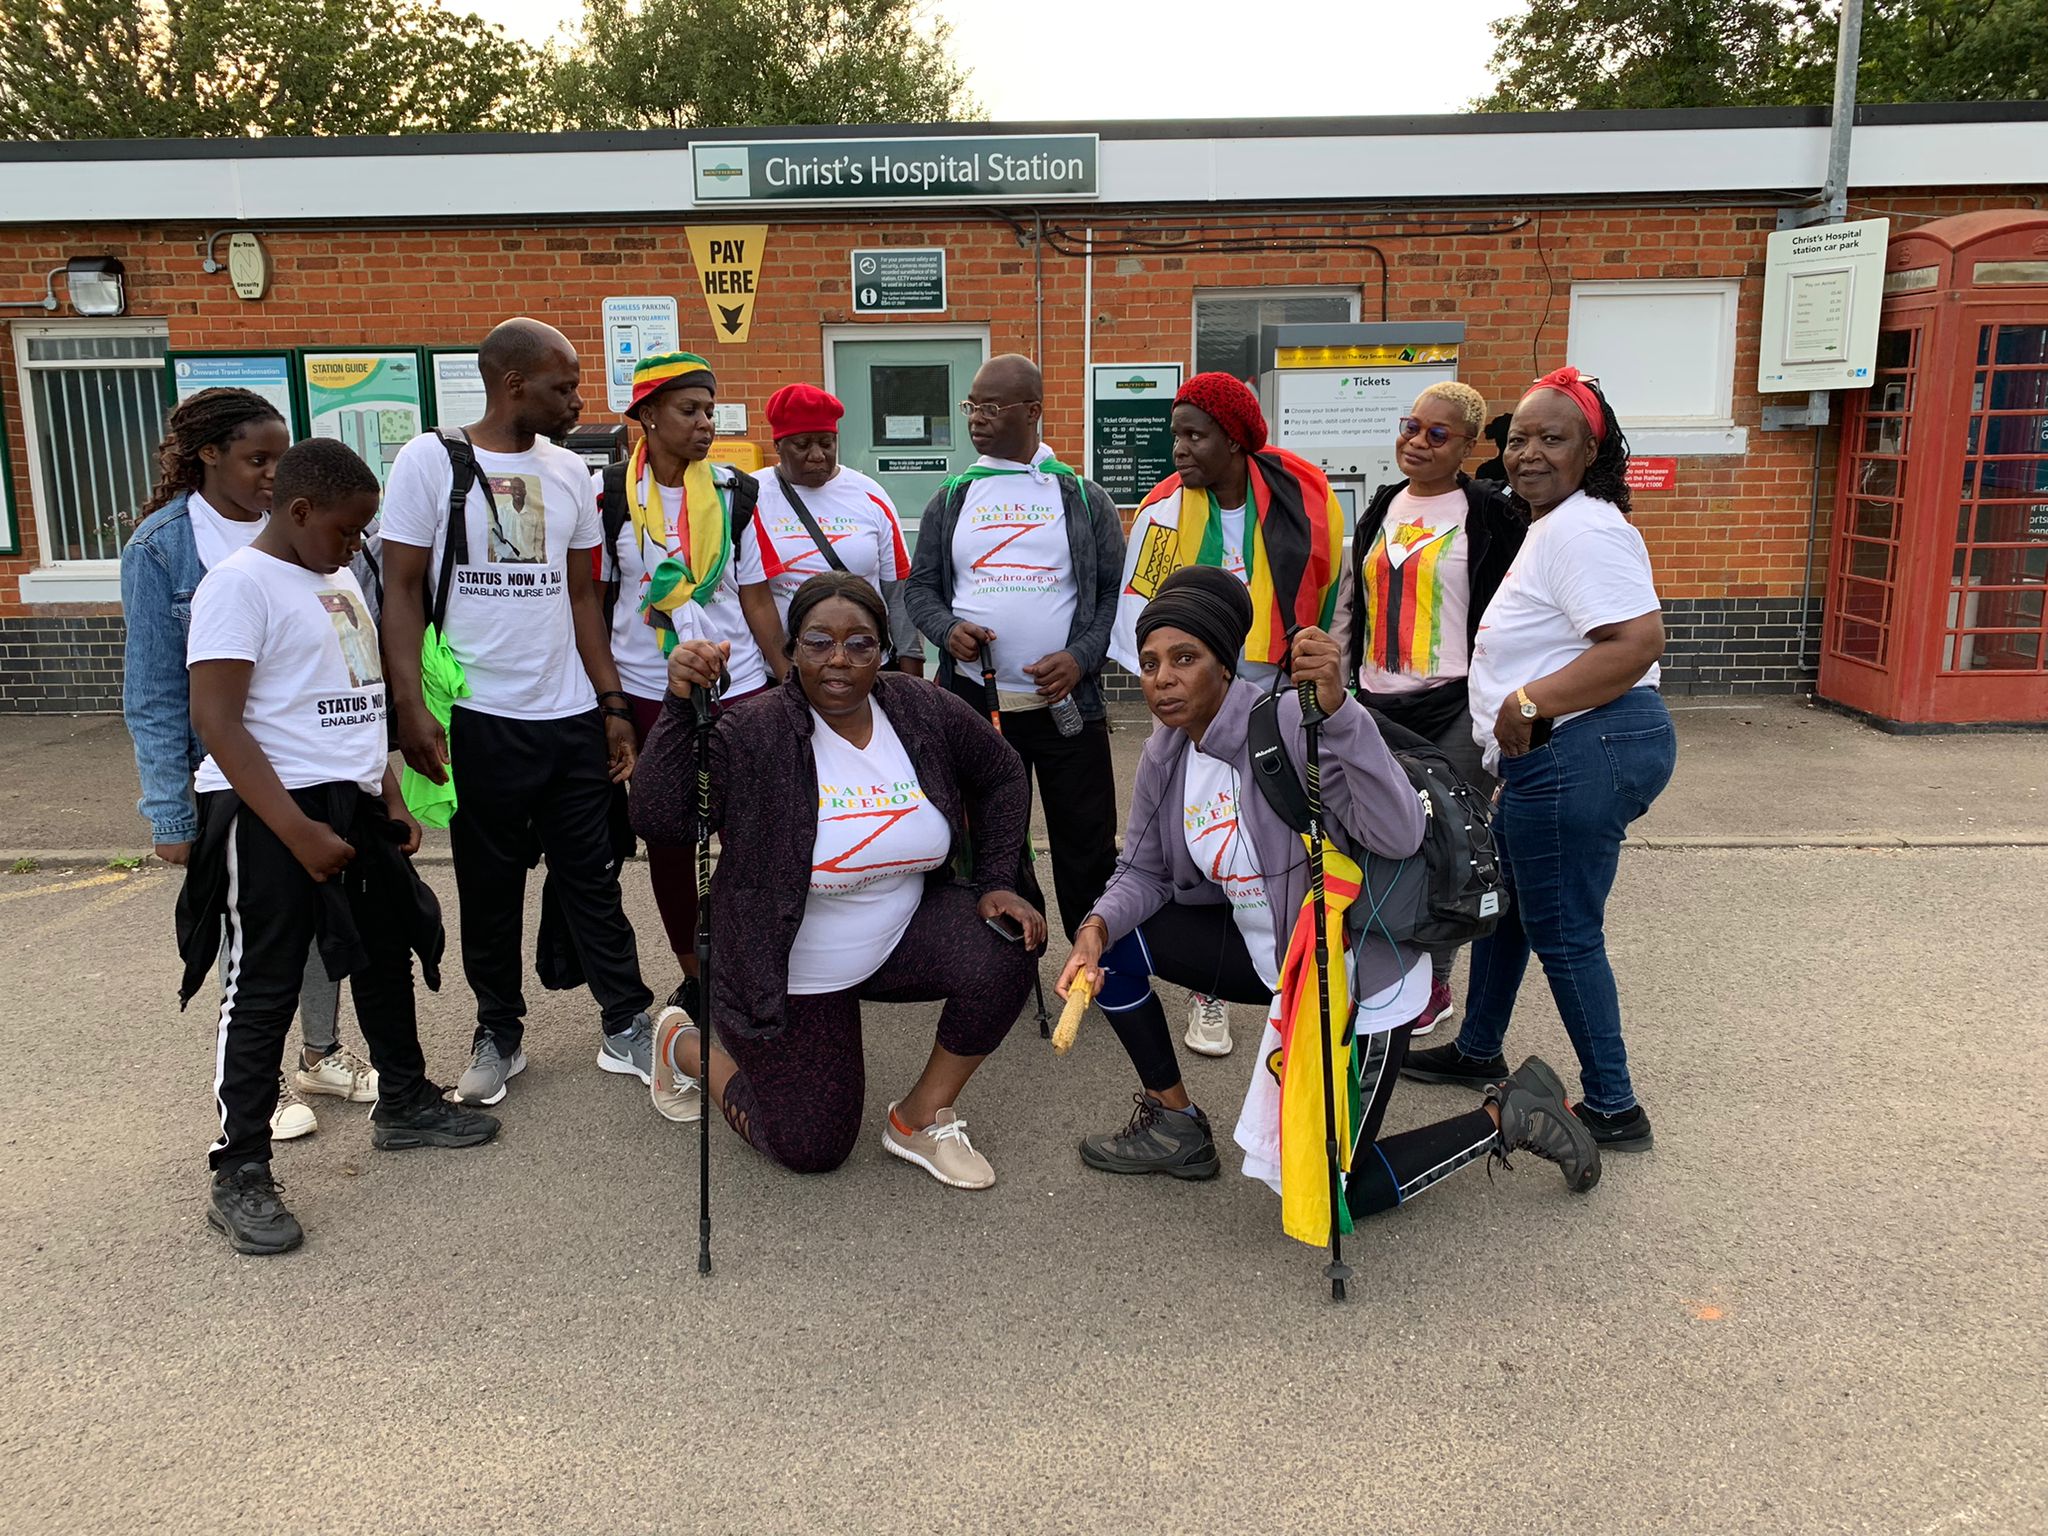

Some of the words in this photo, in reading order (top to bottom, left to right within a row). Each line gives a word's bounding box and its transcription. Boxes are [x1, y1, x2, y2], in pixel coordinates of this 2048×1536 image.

[765, 156, 862, 187] Christ's
[871, 153, 979, 190] Hospital
[987, 152, 1083, 183] Station
[1792, 233, 1823, 246] Christ's
[1825, 228, 1862, 243] Hospital
[710, 240, 745, 264] PAY
[1792, 245, 1822, 256] station
[1823, 243, 1838, 251] car
[1839, 239, 1860, 252] park
[705, 270, 754, 294] HERE
[192, 368, 220, 376] Onward
[312, 363, 344, 374] STATION
[344, 363, 368, 372] GUIDE
[1353, 376, 1390, 386] Tickets
[976, 504, 1026, 513] WALK
[1031, 504, 1052, 512] for
[971, 513, 1055, 524] FREEDOM
[457, 571, 502, 585] STATUS
[507, 573, 535, 586] NOW
[540, 573, 547, 586] 4
[460, 586, 510, 597] ENABLING
[513, 588, 544, 598] NURSE
[317, 696, 368, 715] STATUS
[321, 712, 376, 728] ENABLING
[820, 784, 887, 796] WALK
[893, 780, 916, 792] for
